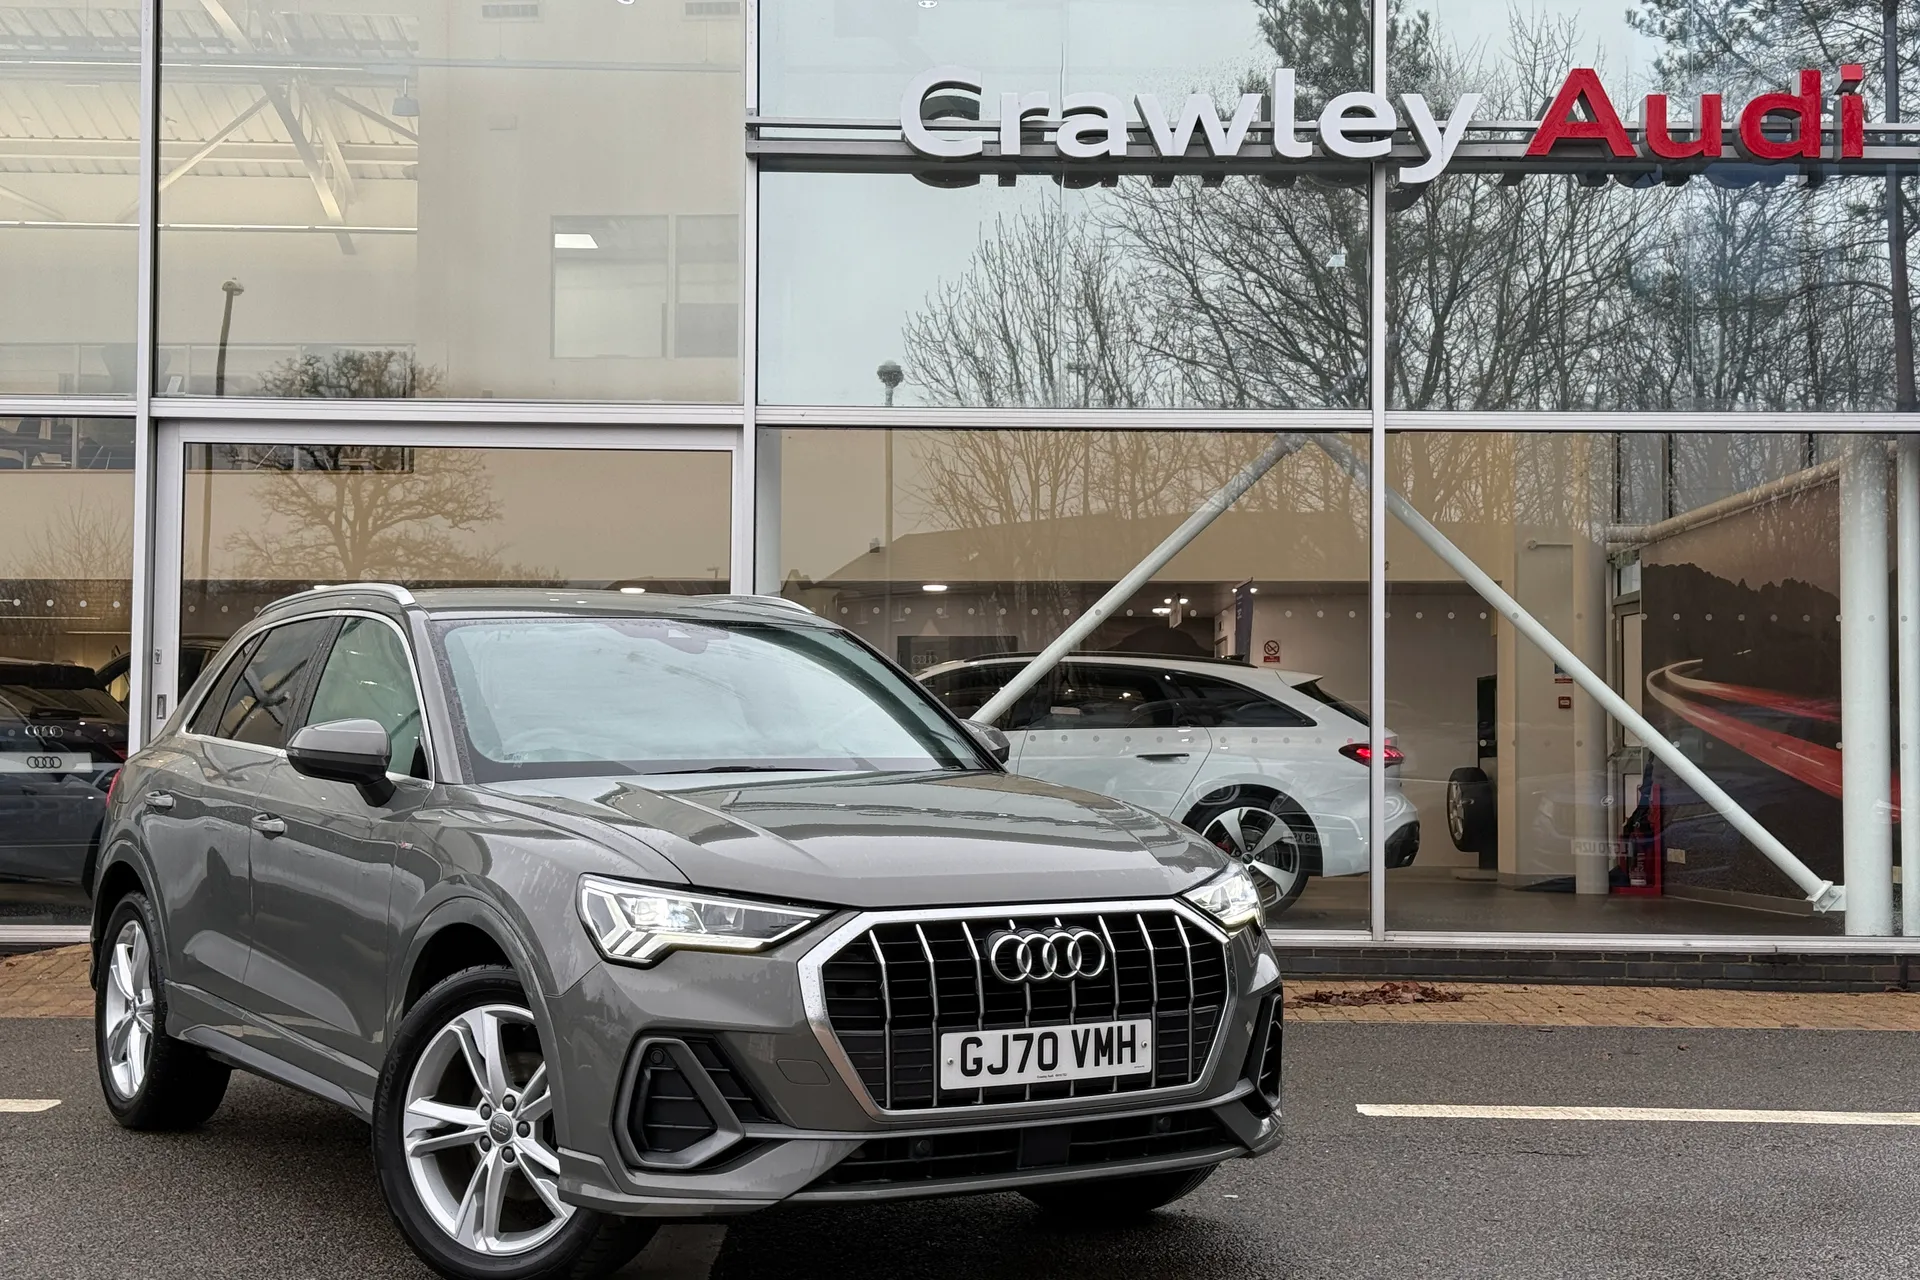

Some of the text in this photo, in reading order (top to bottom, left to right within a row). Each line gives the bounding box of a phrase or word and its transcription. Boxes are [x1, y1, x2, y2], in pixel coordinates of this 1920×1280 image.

[901, 64, 1864, 184] Crawley Audi
[960, 1024, 1136, 1077] GJ70 VMH
